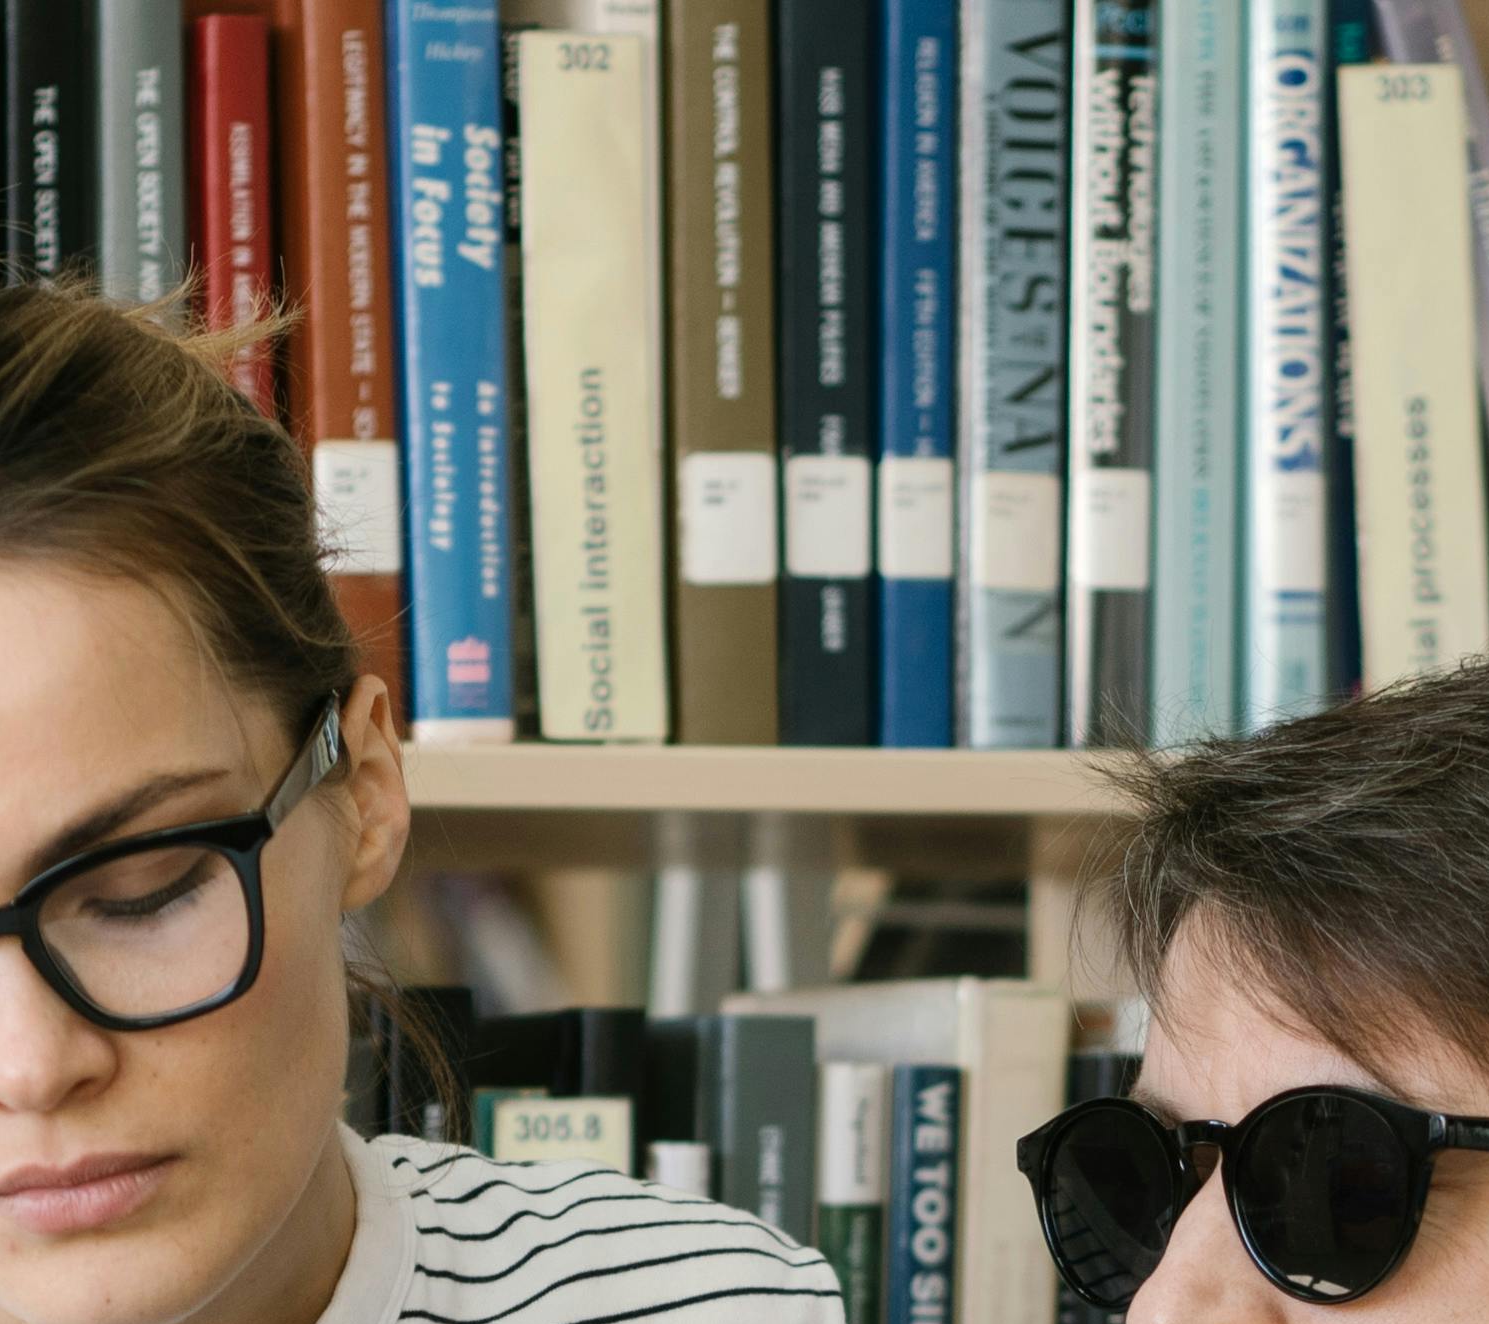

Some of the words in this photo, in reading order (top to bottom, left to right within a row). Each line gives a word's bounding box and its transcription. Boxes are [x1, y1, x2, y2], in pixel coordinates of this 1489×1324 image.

[557, 43, 612, 72] 302
[713, 22, 740, 61] THE
[33, 84, 60, 126] THE
[136, 67, 163, 107] THE
[341, 29, 368, 147] LEGITIMACY
[713, 65, 740, 158] CONTROL
[1375, 74, 1430, 102] 303
[33, 129, 60, 187] OPEN
[136, 111, 163, 168] OPEN
[411, 122, 452, 166] in
[1004, 30, 1059, 313] VOICES
[33, 188, 60, 272] SOCIETY
[137, 170, 163, 259] SOCIETY
[347, 181, 371, 220] THE
[411, 177, 452, 289] Focus
[458, 122, 503, 271] Society
[715, 161, 741, 289] REVOLUTION
[349, 223, 372, 311] MODERN
[1271, 54, 1321, 462] ORGANIZATIONS
[431, 380, 452, 411] to
[428, 421, 458, 552] Sociology
[478, 423, 502, 598] Introduction
[573, 366, 612, 593] interaction
[1406, 397, 1441, 604] processes
[581, 604, 615, 734] Social
[913, 1081, 955, 1151] WE
[911, 1163, 952, 1266] TOO
